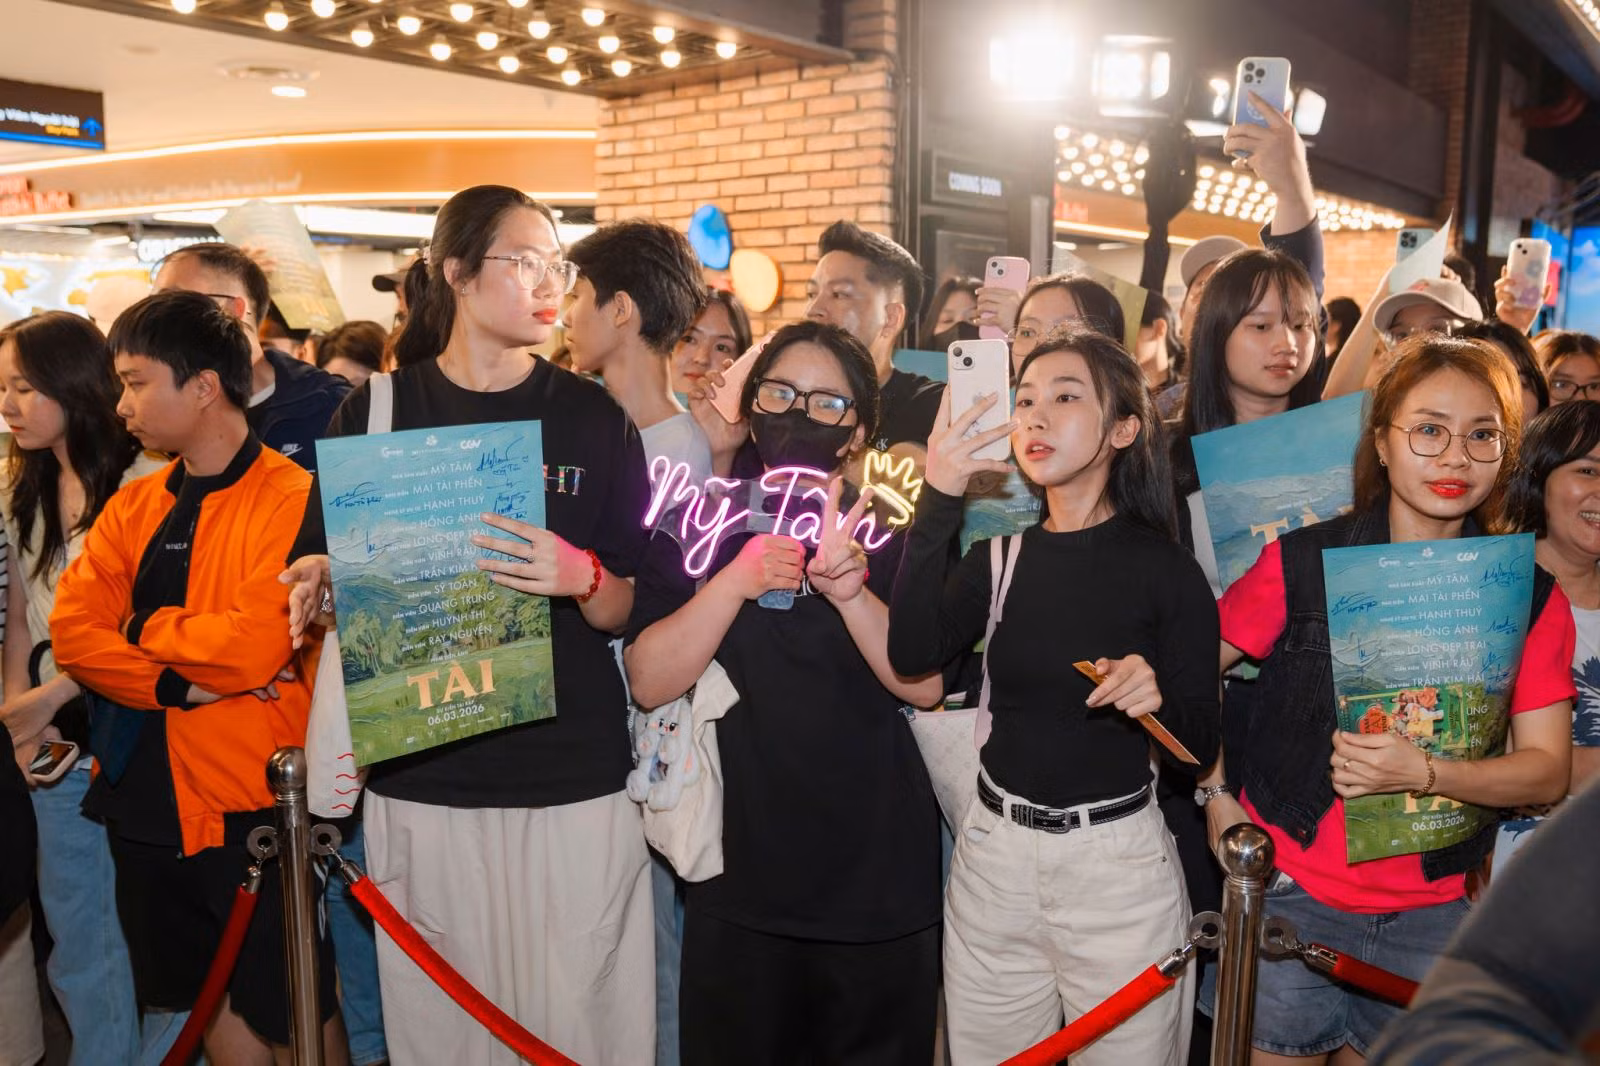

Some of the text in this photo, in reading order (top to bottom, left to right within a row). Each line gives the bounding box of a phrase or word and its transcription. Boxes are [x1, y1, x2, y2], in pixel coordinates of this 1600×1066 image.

[460, 440, 481, 450] CGV
[430, 461, 472, 474] MỸ TÂM
[413, 484, 432, 494] MAI
[436, 478, 451, 490] TÀI
[424, 499, 454, 512] HẠNH
[414, 534, 442, 546] LONG
[1456, 552, 1479, 562] CGV
[449, 564, 468, 574] KIM
[1427, 576, 1442, 585] MỸ
[1446, 573, 1468, 584] TÂM
[418, 598, 458, 614] QUANG
[461, 592, 496, 605] TRUNG
[1408, 594, 1428, 604] MAI
[1432, 592, 1448, 602] TÀI
[470, 610, 486, 620] THI
[1418, 610, 1452, 621] HẠNH
[428, 634, 446, 646] RAY
[450, 622, 492, 640] NGUYỄN
[1408, 644, 1440, 654] LONG
[1464, 640, 1486, 650] TRAI
[1422, 660, 1449, 670] VINH
[407, 658, 496, 710] TÀI
[428, 704, 484, 726] 06.03.2026
[1412, 815, 1465, 831] 06.03.2026
